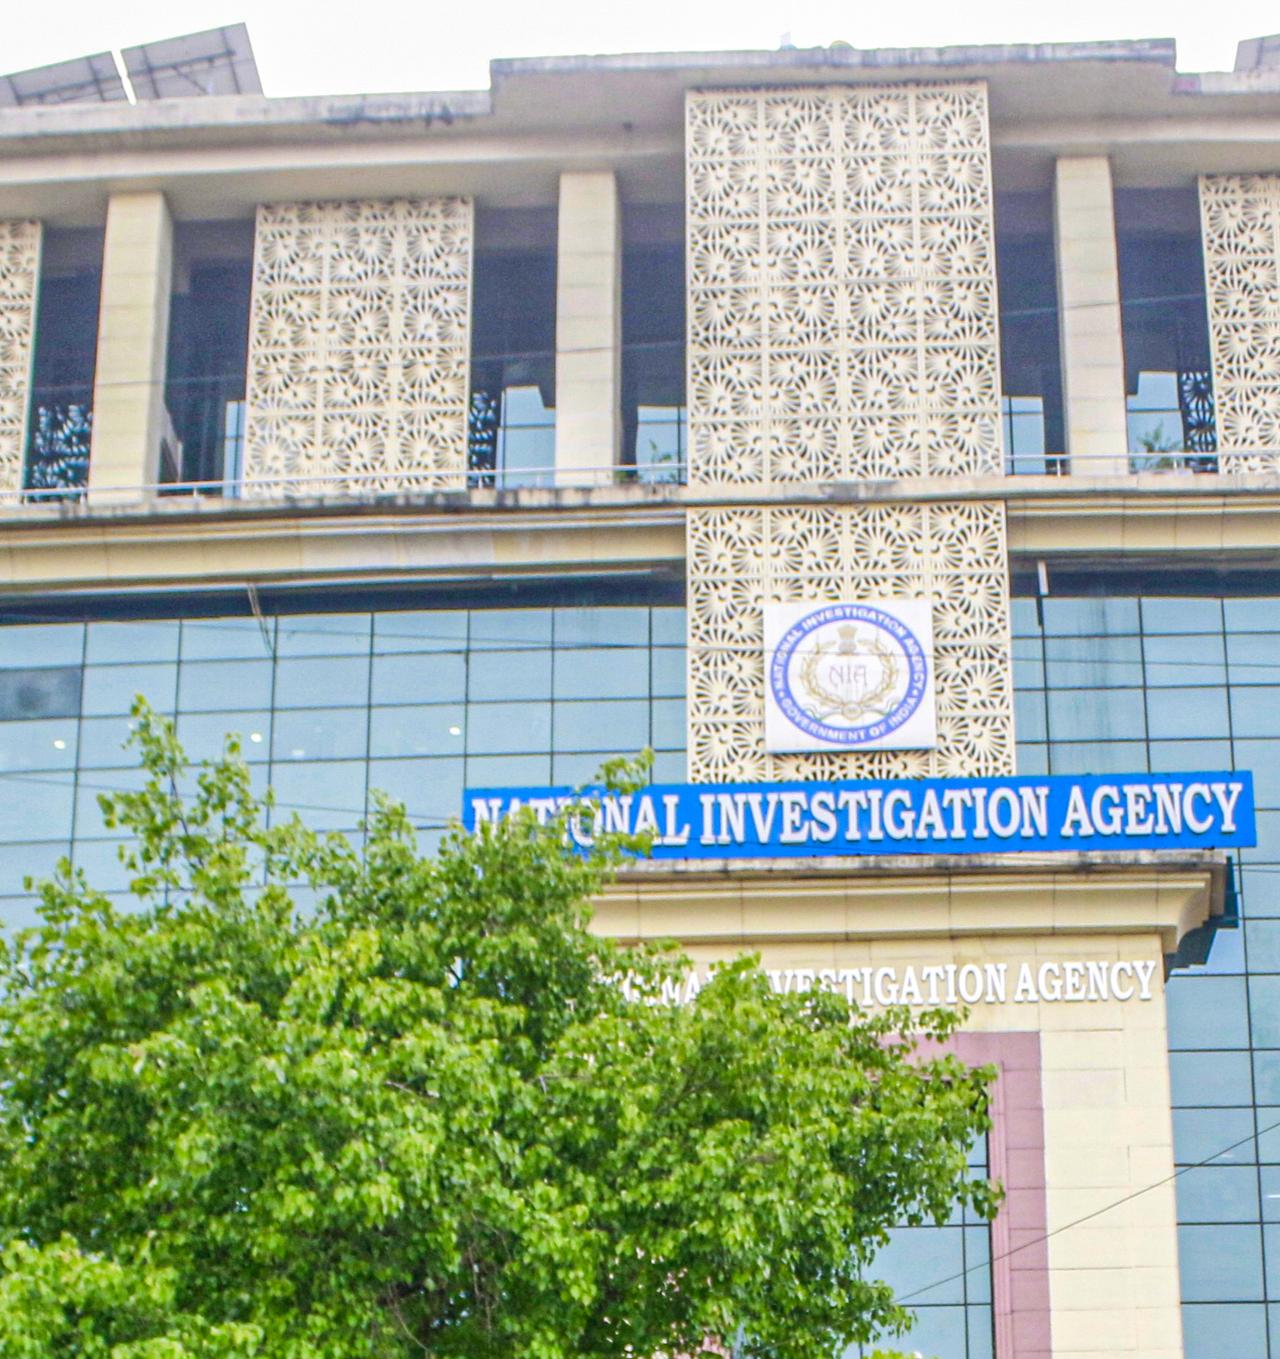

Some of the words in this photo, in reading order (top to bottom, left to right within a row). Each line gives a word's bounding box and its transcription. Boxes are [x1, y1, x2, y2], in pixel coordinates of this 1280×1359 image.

[773, 627, 803, 690] NATIONAL
[801, 606, 908, 638] INVESTIGATION
[828, 664, 868, 687] NIA
[781, 698, 867, 741] GOVERNMENT
[869, 723, 888, 736] OF
[888, 697, 918, 728] INDIA
[699, 787, 1049, 845] INVESTIGATION
[1061, 783, 1243, 837] AGENCY
[738, 963, 1007, 1010] VESTIGATION
[1014, 960, 1156, 1002] AGENCY
